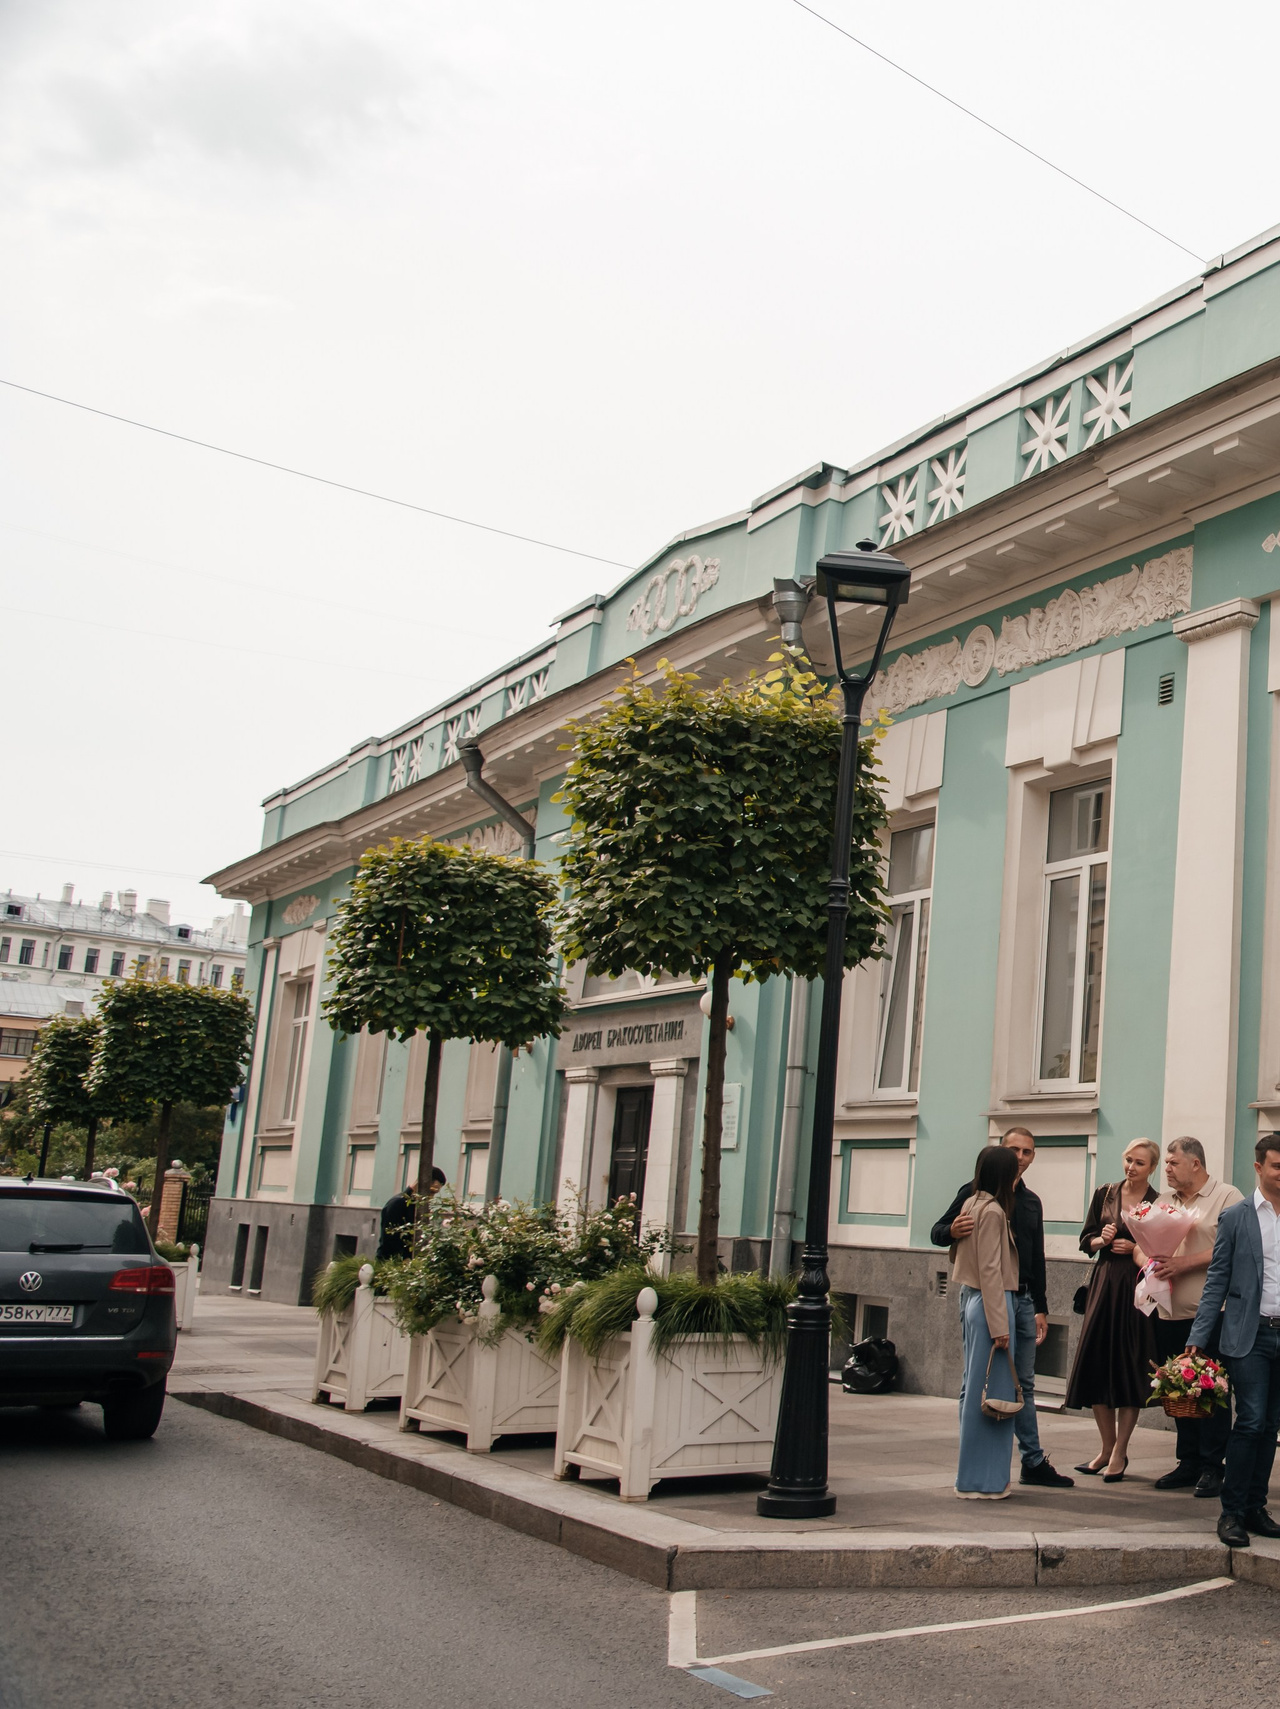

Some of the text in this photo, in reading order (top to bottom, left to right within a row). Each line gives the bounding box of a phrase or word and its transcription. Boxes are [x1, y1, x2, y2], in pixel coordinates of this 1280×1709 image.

[572, 1020, 684, 1052] ДВОРЕЦ БРАКОСОЧЕТАНИЯ
[47, 1306, 70, 1317] 777
